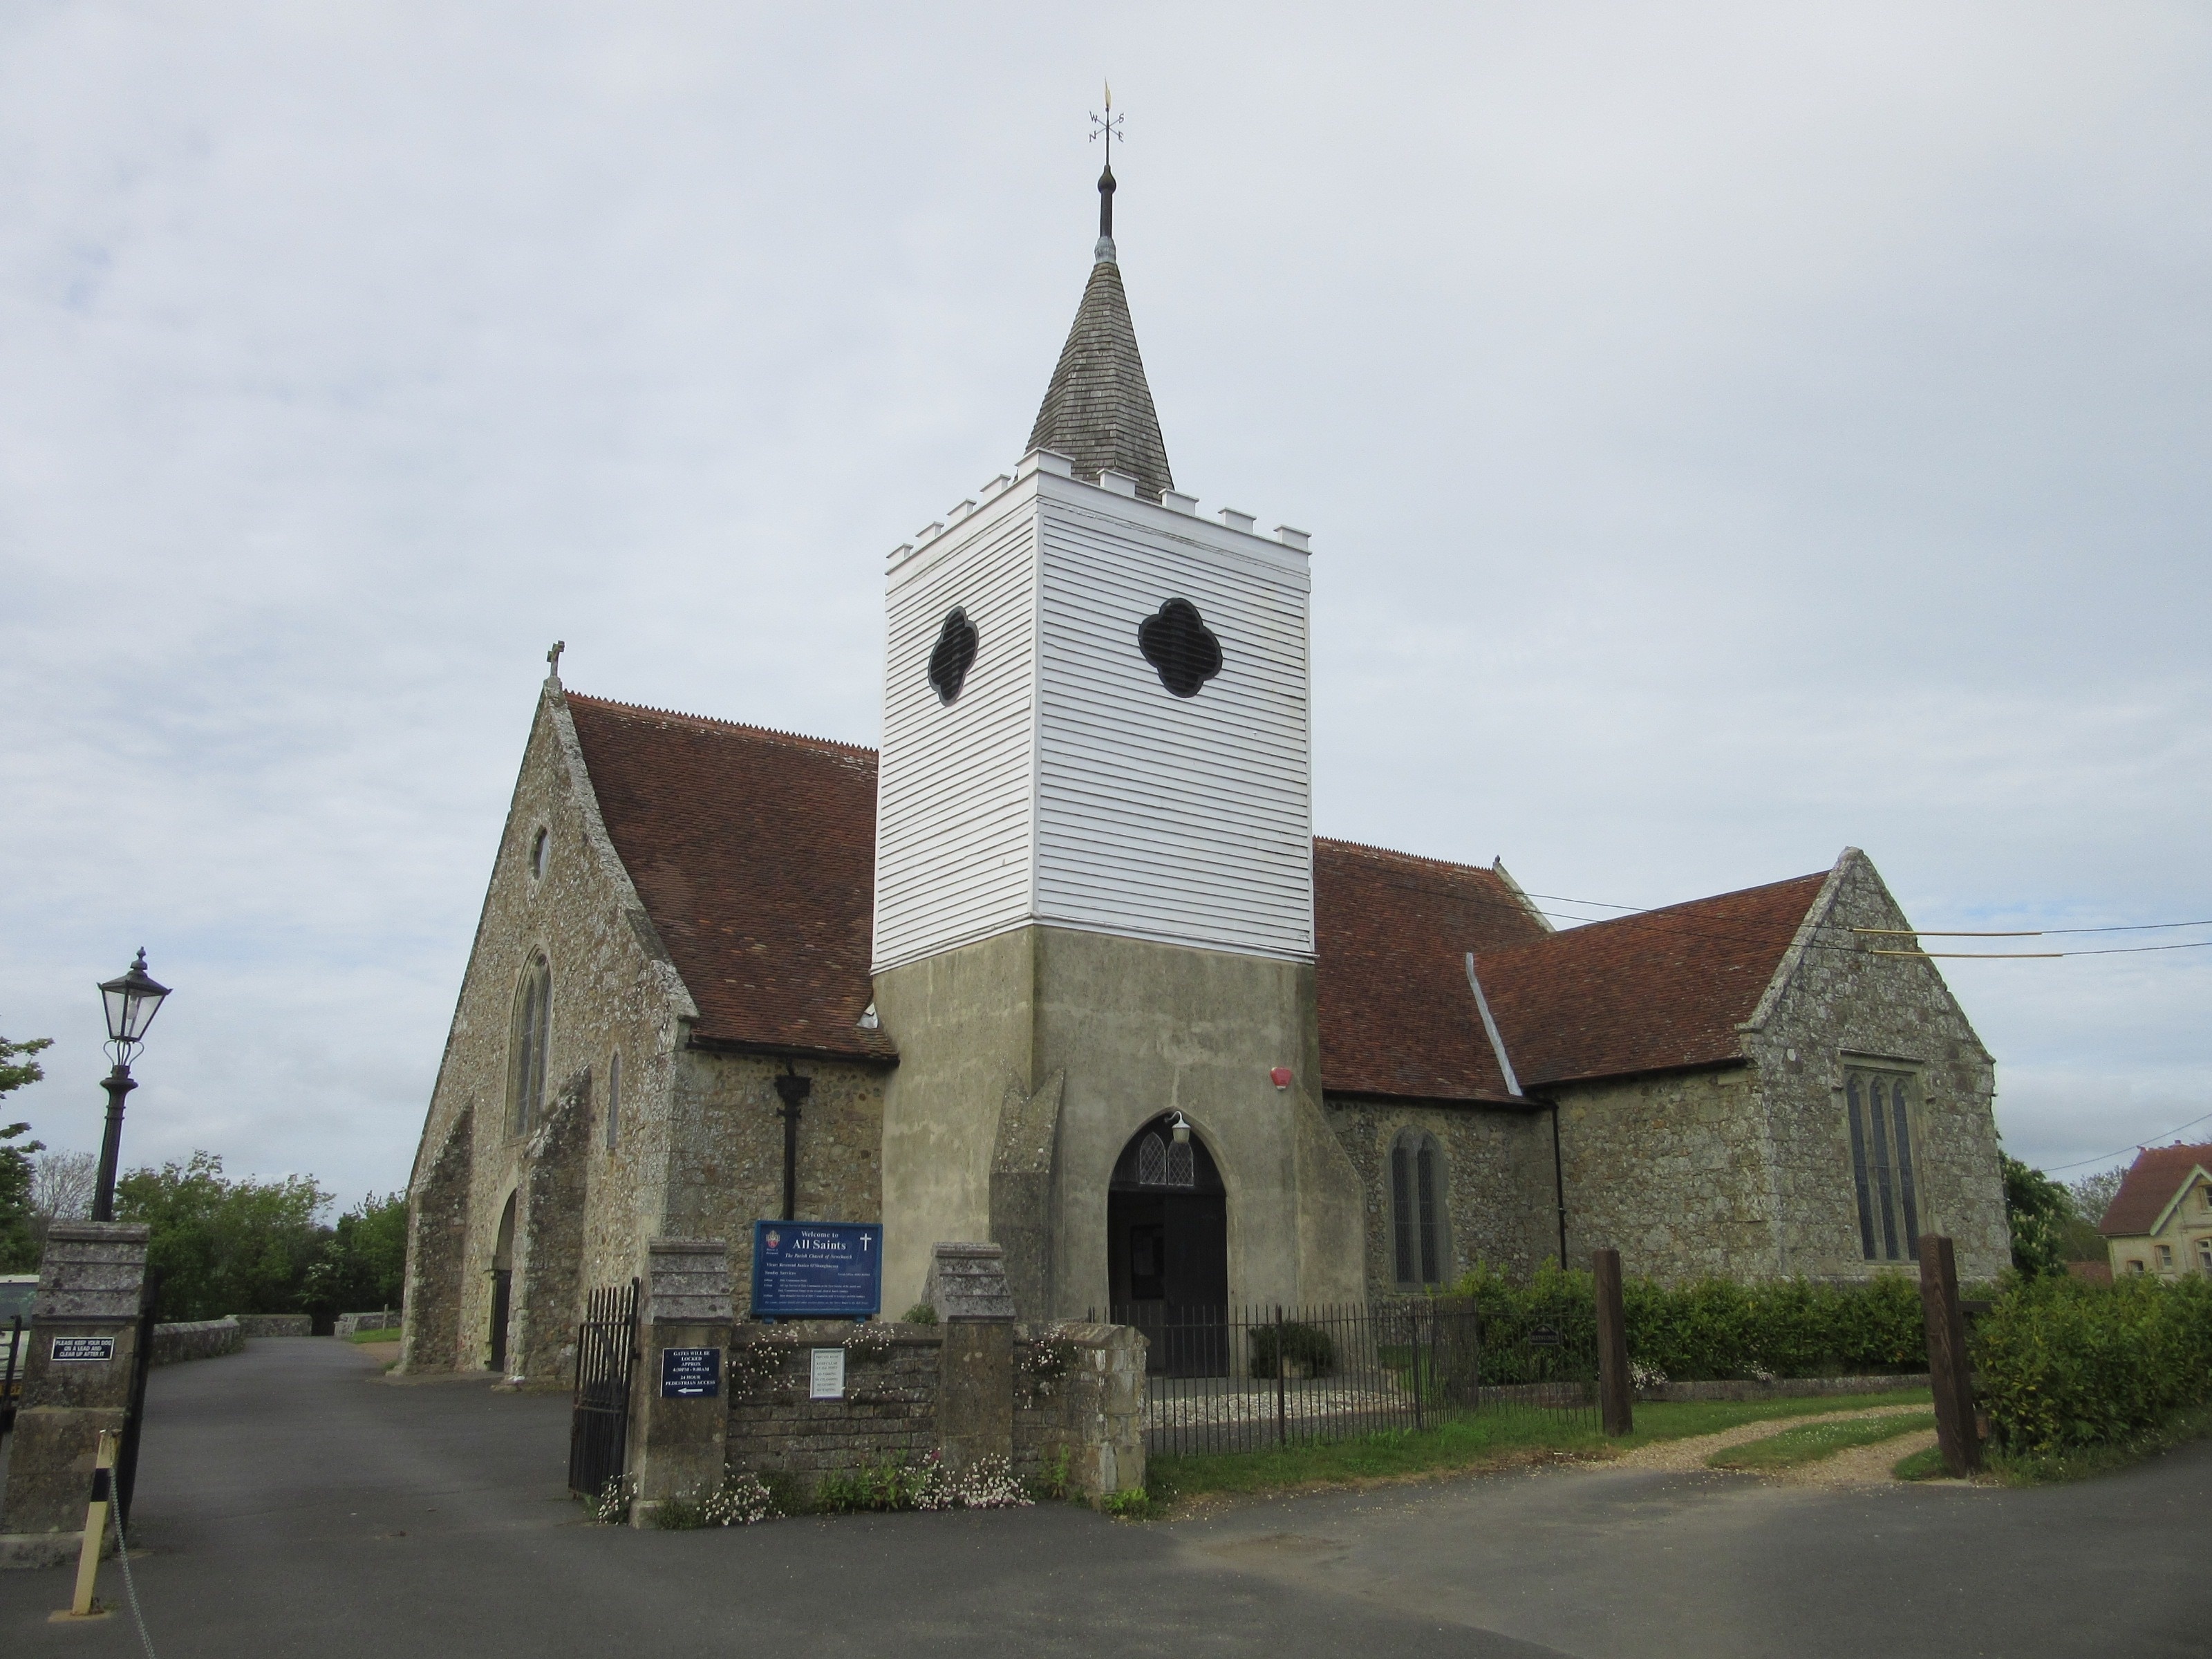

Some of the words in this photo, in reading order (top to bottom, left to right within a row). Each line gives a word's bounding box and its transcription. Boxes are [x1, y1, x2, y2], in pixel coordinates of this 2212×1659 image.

[1089, 111, 1098, 124] W
[1118, 113, 1125, 123] S
[1089, 130, 1096, 143] N
[1118, 131, 1124, 142] E
[792, 1239, 809, 1249] All
[812, 1239, 846, 1250] Saints
